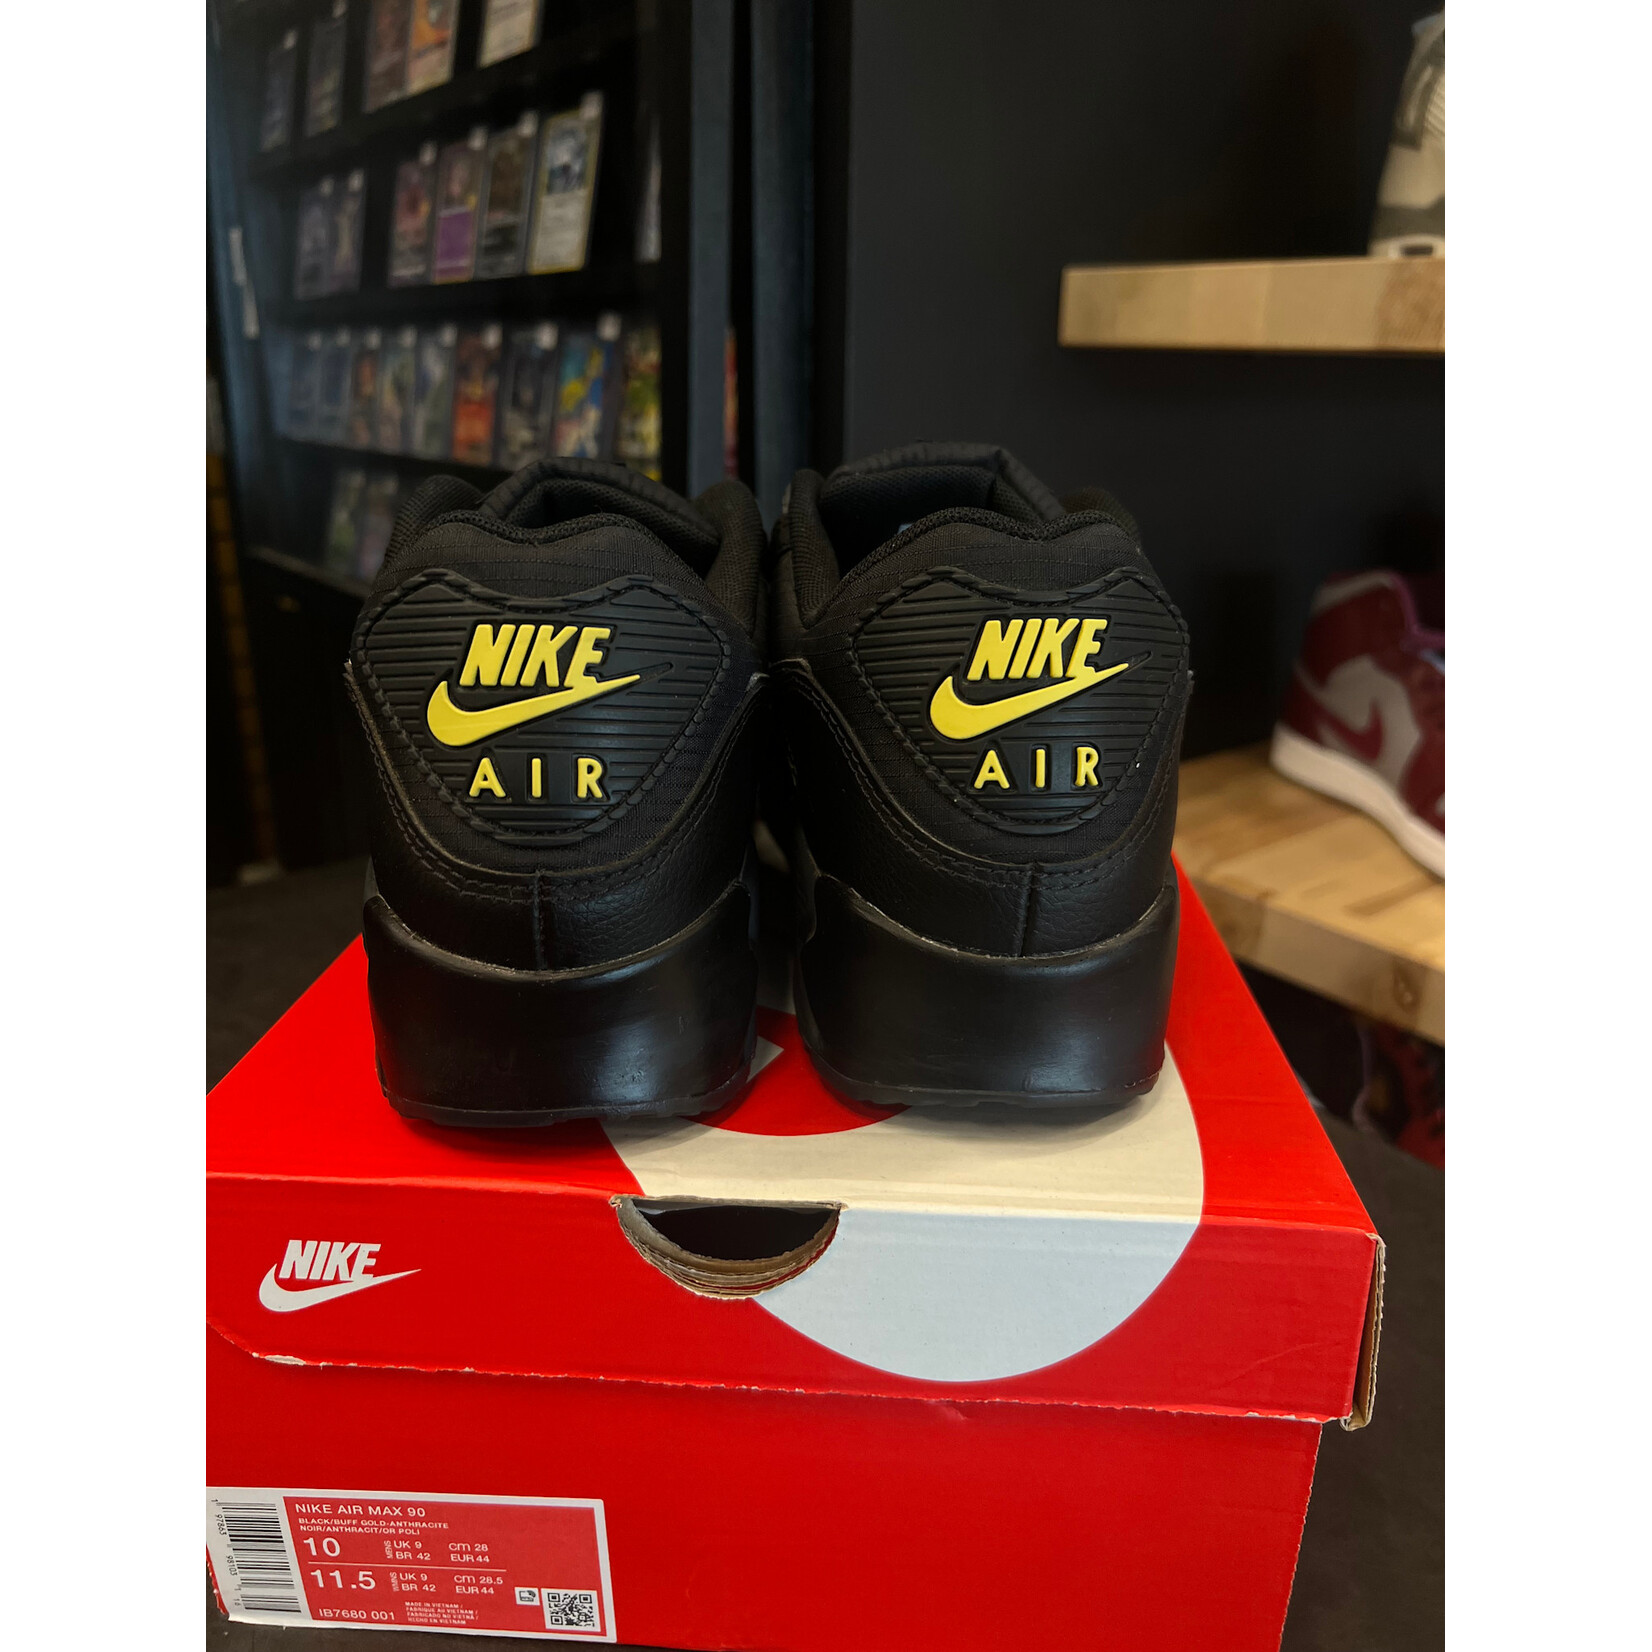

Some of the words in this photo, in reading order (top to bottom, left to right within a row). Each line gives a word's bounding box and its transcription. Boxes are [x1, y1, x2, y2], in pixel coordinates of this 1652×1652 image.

[459, 624, 611, 688] NIKE
[967, 618, 1107, 679] NIKE
[973, 746, 1099, 789] AIR
[469, 757, 603, 798] AIR
[278, 1239, 382, 1281] NIKE
[295, 1503, 333, 1514] NIKE
[337, 1504, 364, 1515] AIR
[368, 1505, 403, 1516] MAX
[407, 1507, 426, 1517] 90
[298, 1518, 358, 1526] BLACK/BUFF
[360, 1519, 449, 1529] GOLD-ANTHRACITE
[300, 1525, 396, 1535] NOIR/ANTHRACIT/OR
[215, 1513, 227, 1536] 97863
[226, 1555, 238, 1576] 98103
[303, 1537, 341, 1557] 10
[384, 1540, 393, 1559] MENS
[393, 1540, 411, 1549] UK
[414, 1540, 422, 1549] 9
[474, 1543, 489, 1552] 28
[395, 1551, 412, 1560] BR
[416, 1552, 431, 1560] 42
[450, 1553, 475, 1562] EUR
[475, 1555, 490, 1563] 44
[310, 1569, 376, 1590] 11.5
[399, 1572, 417, 1581] UK
[420, 1573, 428, 1581] 9
[479, 1576, 504, 1585] 28.5
[401, 1583, 418, 1591] BR
[422, 1584, 437, 1592] 42
[455, 1585, 479, 1594] EUR
[480, 1586, 495, 1595] 44
[318, 1608, 367, 1619] IB7680
[371, 1610, 395, 1621] 001
